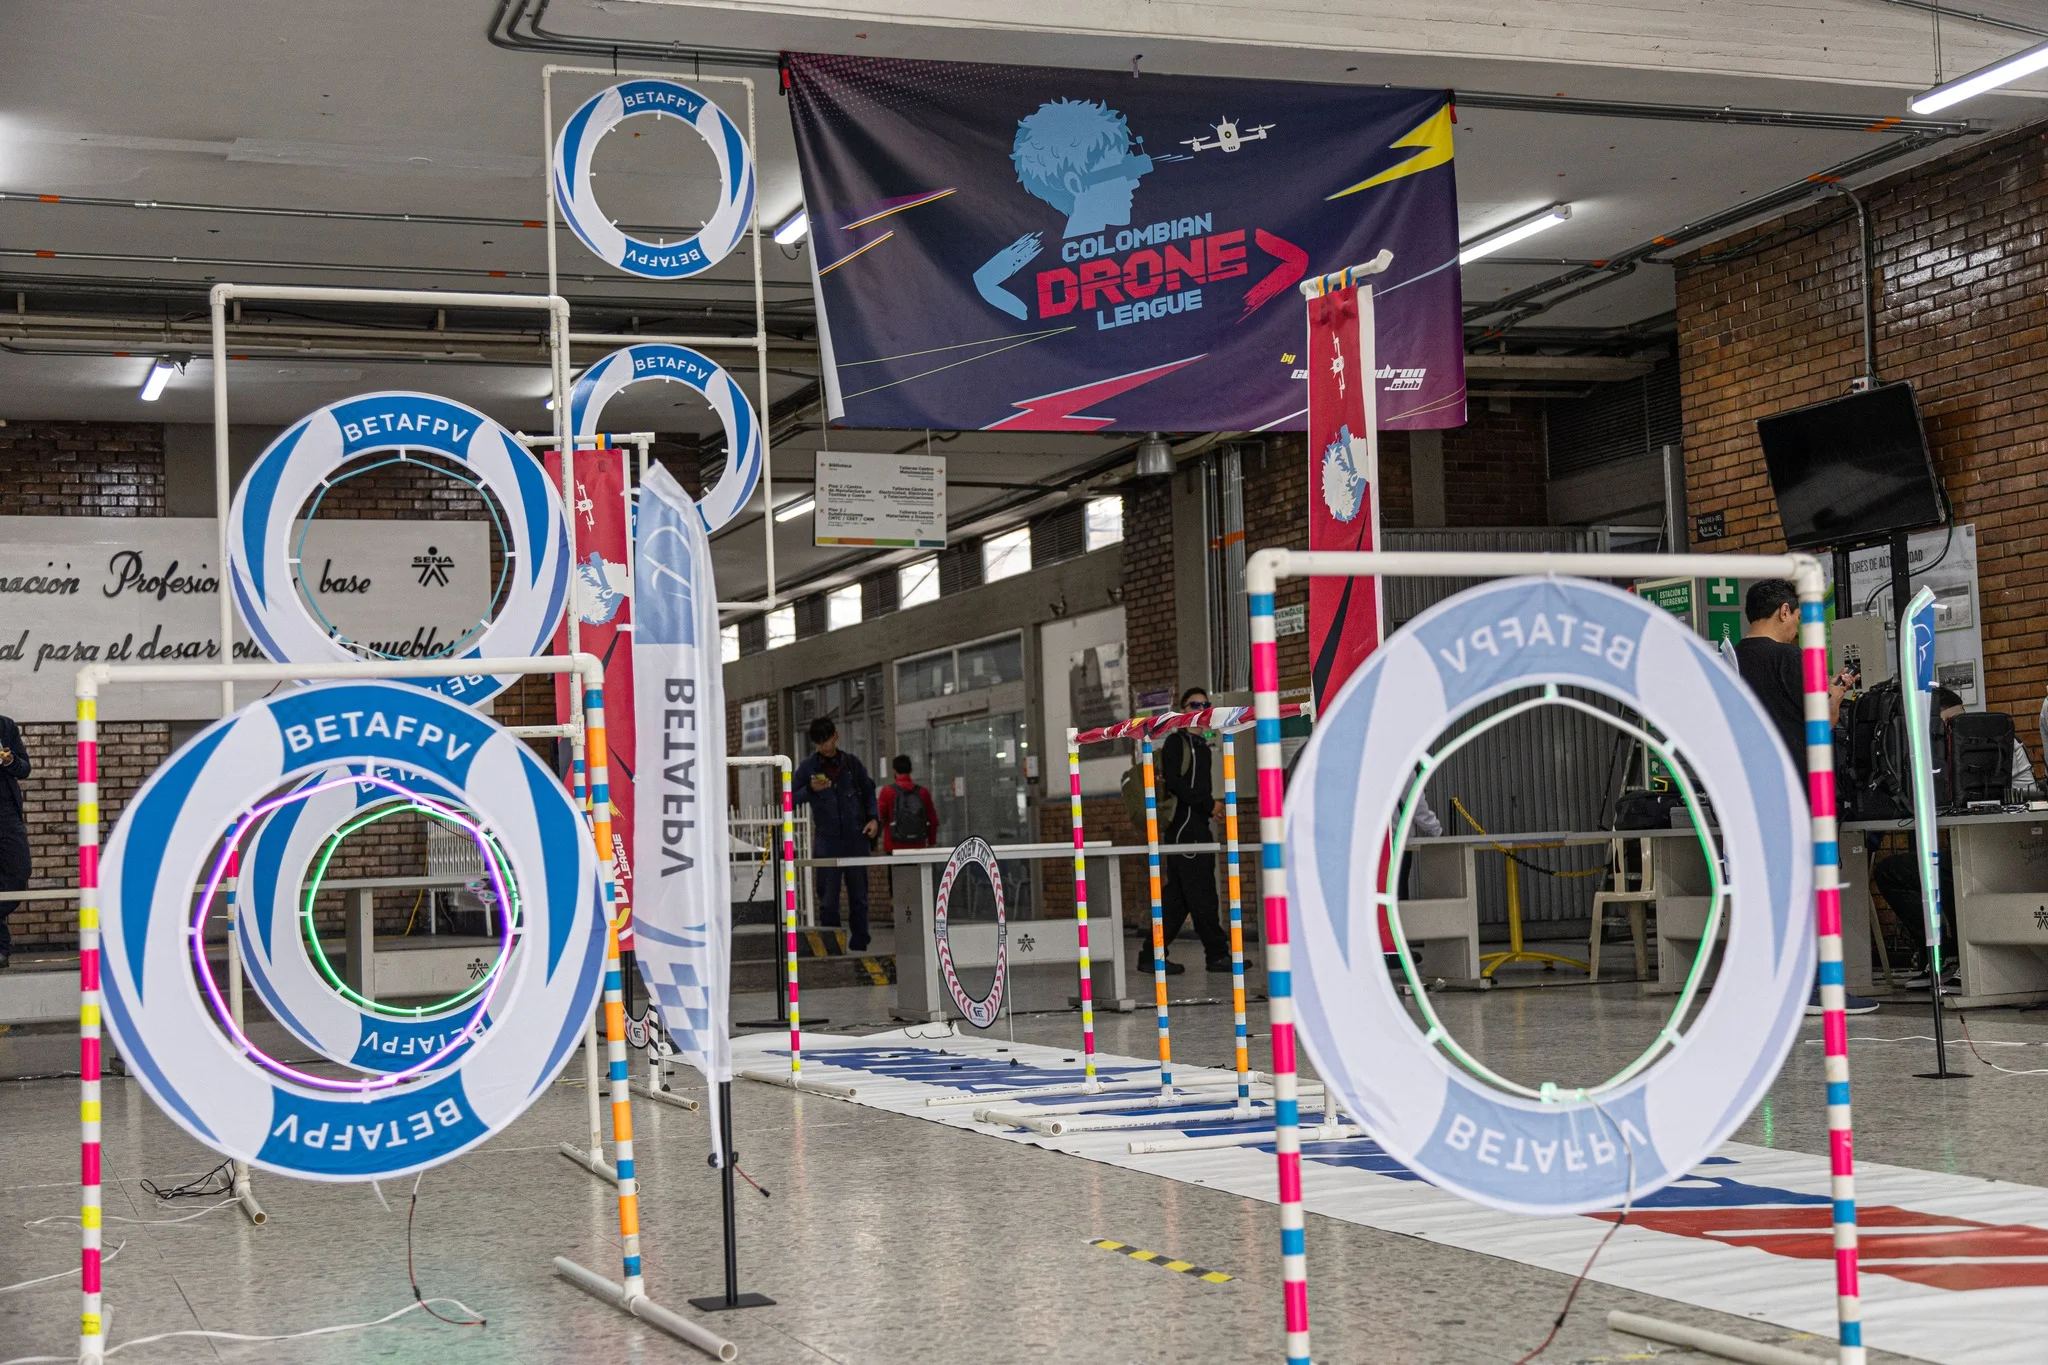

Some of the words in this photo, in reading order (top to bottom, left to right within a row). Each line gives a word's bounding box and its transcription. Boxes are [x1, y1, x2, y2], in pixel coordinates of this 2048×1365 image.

[624, 91, 698, 114] BETAFPV
[1062, 212, 1212, 263] COLOMBIAN
[626, 249, 701, 268] BETAFPV
[1036, 229, 1248, 319] DRONE
[1097, 289, 1203, 331] LEAGUE
[635, 356, 709, 380] BETAFPV
[1280, 353, 1296, 364] by
[343, 413, 468, 443] BETAFPV
[413, 556, 453, 564] SENA
[1878, 556, 1891, 568] ALT
[319, 559, 372, 594] base
[1660, 588, 1681, 599] ESTACIÓN
[1682, 587, 1688, 595] DE
[1660, 596, 1689, 608] EMERGENCIA
[33, 641, 100, 673] para
[105, 633, 133, 661] el
[285, 711, 471, 762] BETAFPV
[612, 833, 632, 879] LEAGUE
[273, 1098, 463, 1151] BETAFPV
